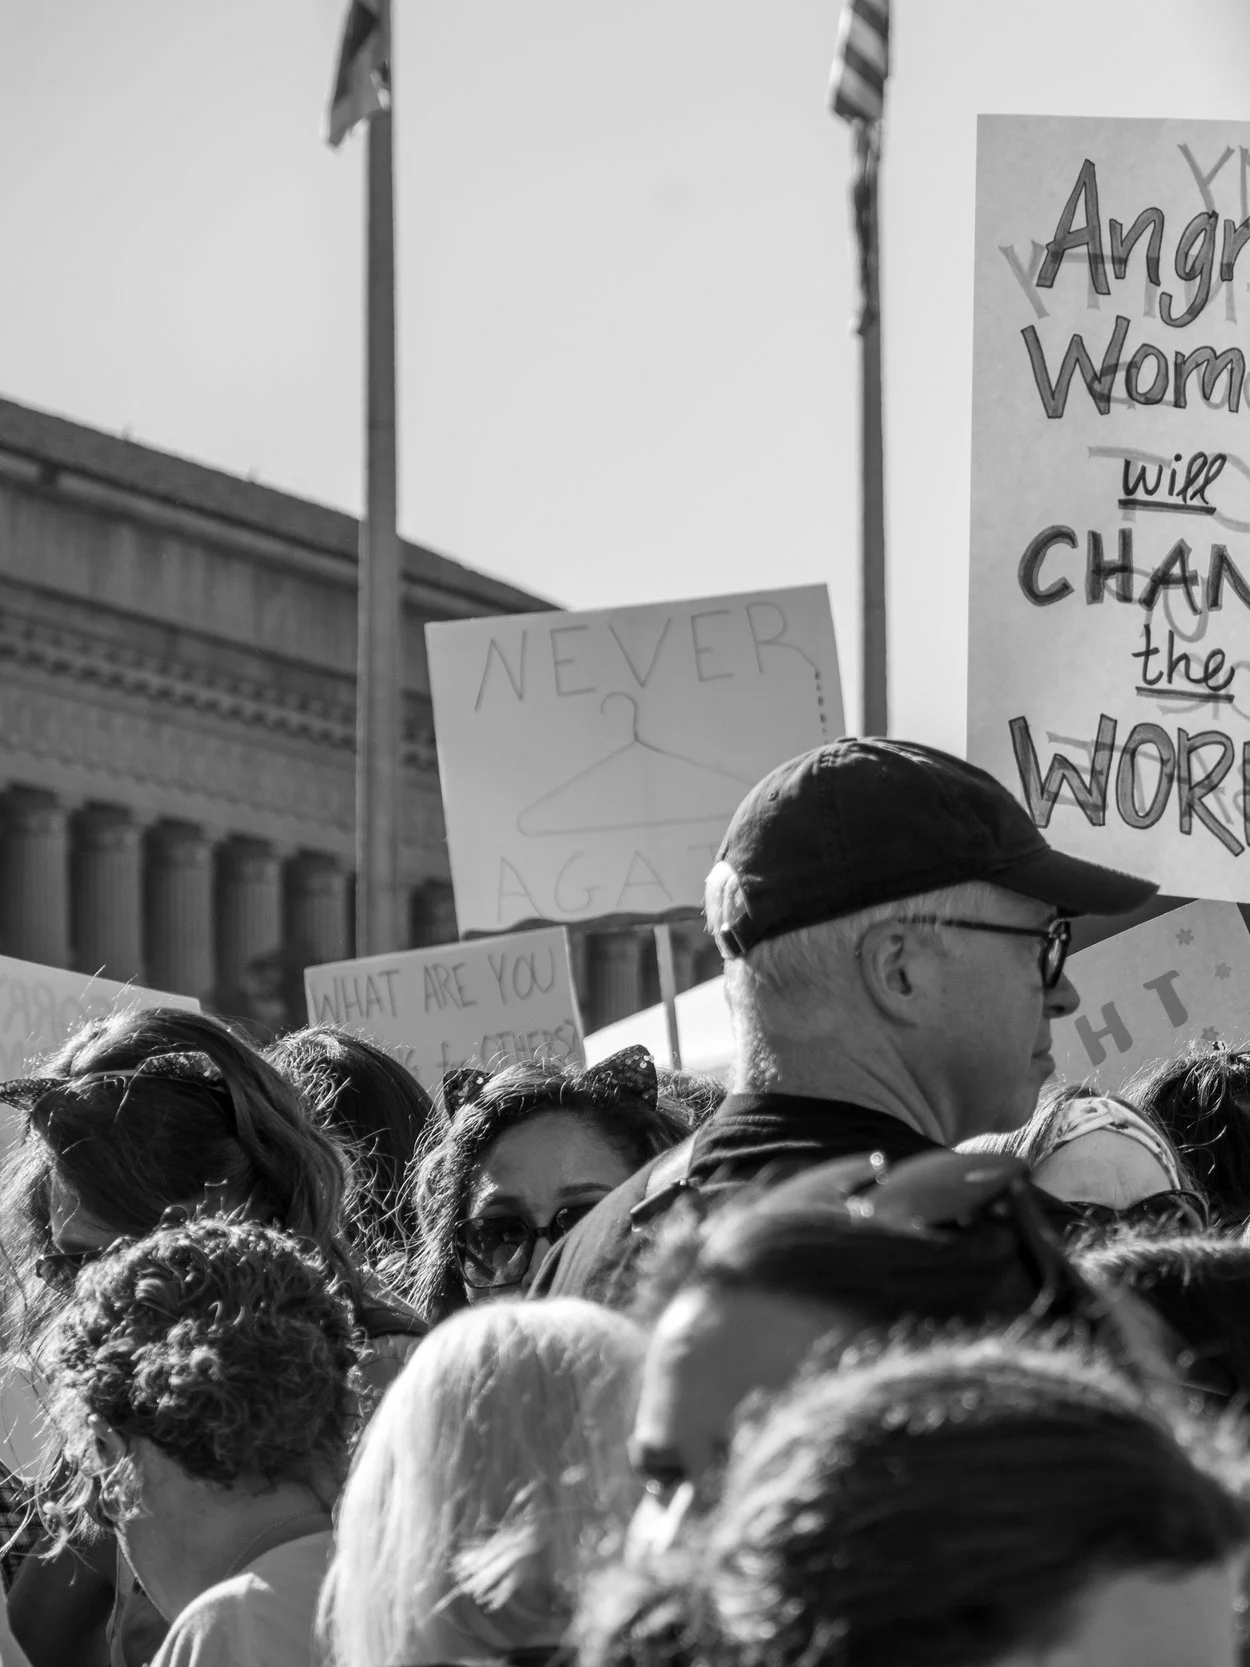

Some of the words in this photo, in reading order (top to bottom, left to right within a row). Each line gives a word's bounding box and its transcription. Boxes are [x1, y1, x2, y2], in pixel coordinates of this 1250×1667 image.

[1122, 452, 1228, 504] will
[474, 601, 818, 713] NEVER
[1132, 624, 1235, 692] the
[307, 968, 400, 1024] WHAT
[422, 961, 477, 1015] ARE
[486, 946, 556, 1006] YOU
